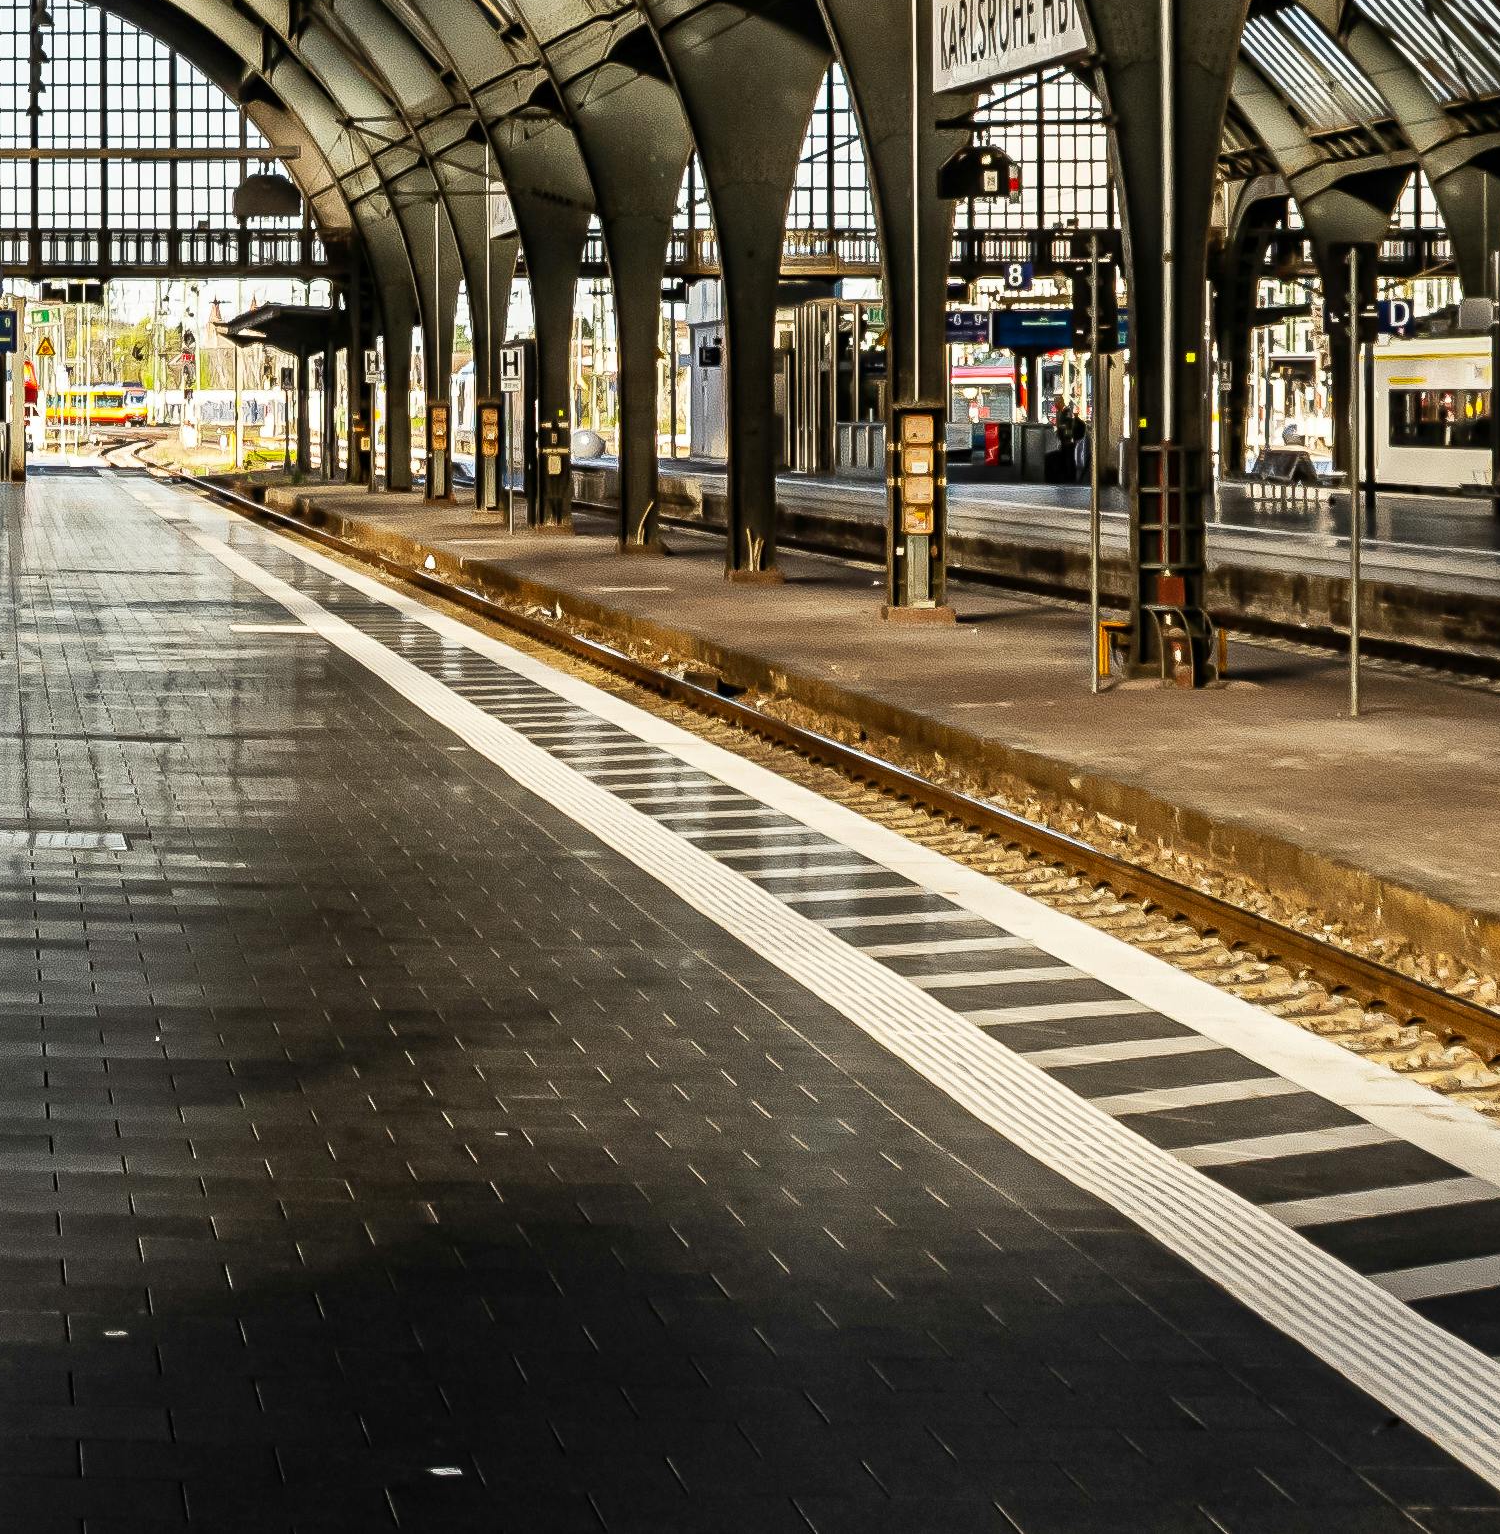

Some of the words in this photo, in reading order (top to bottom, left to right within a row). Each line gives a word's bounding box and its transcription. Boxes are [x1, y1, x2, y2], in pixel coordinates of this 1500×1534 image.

[1008, 263, 1023, 287] 8
[1390, 300, 1410, 327] D
[502, 351, 519, 377] H
